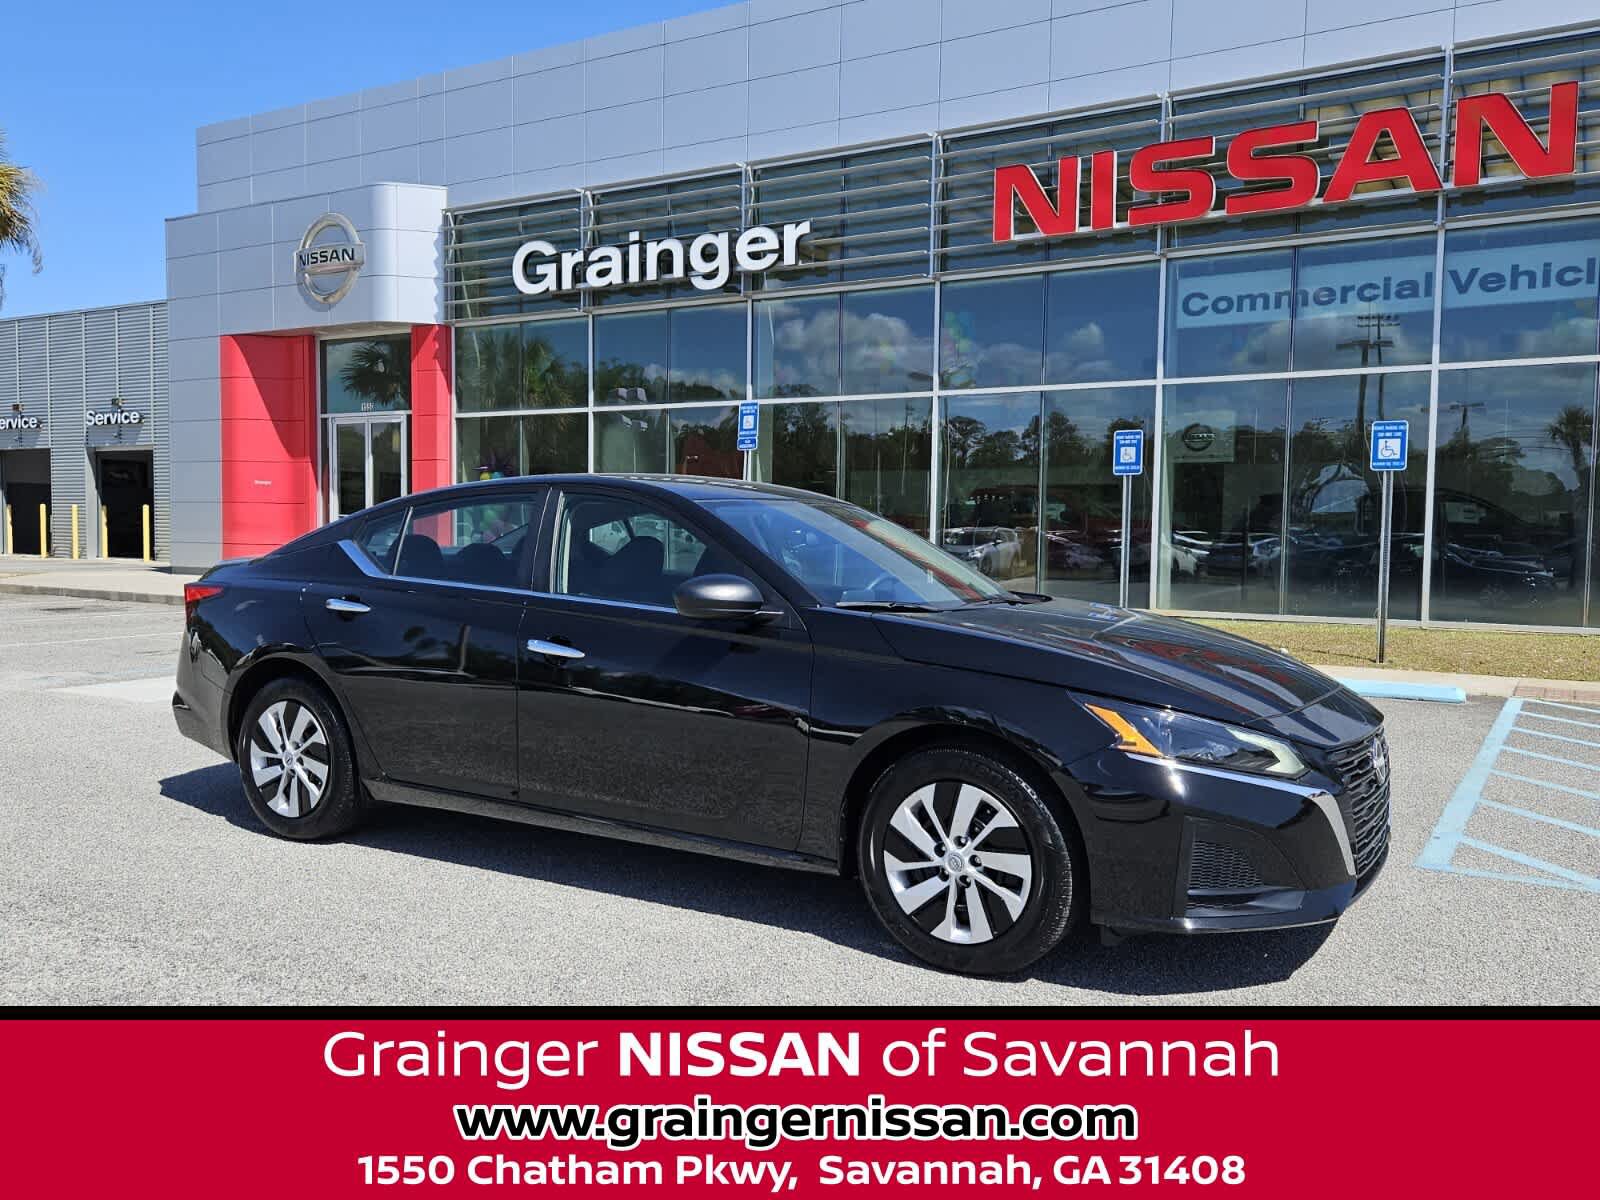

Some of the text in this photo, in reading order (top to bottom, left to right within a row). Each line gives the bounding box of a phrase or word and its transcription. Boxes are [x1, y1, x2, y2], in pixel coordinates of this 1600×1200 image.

[993, 81, 1578, 242] NISSAN
[299, 248, 354, 266] NISSAN
[512, 219, 811, 295] Grainger
[1181, 271, 1434, 317] Commercial
[86, 409, 140, 425] Service
